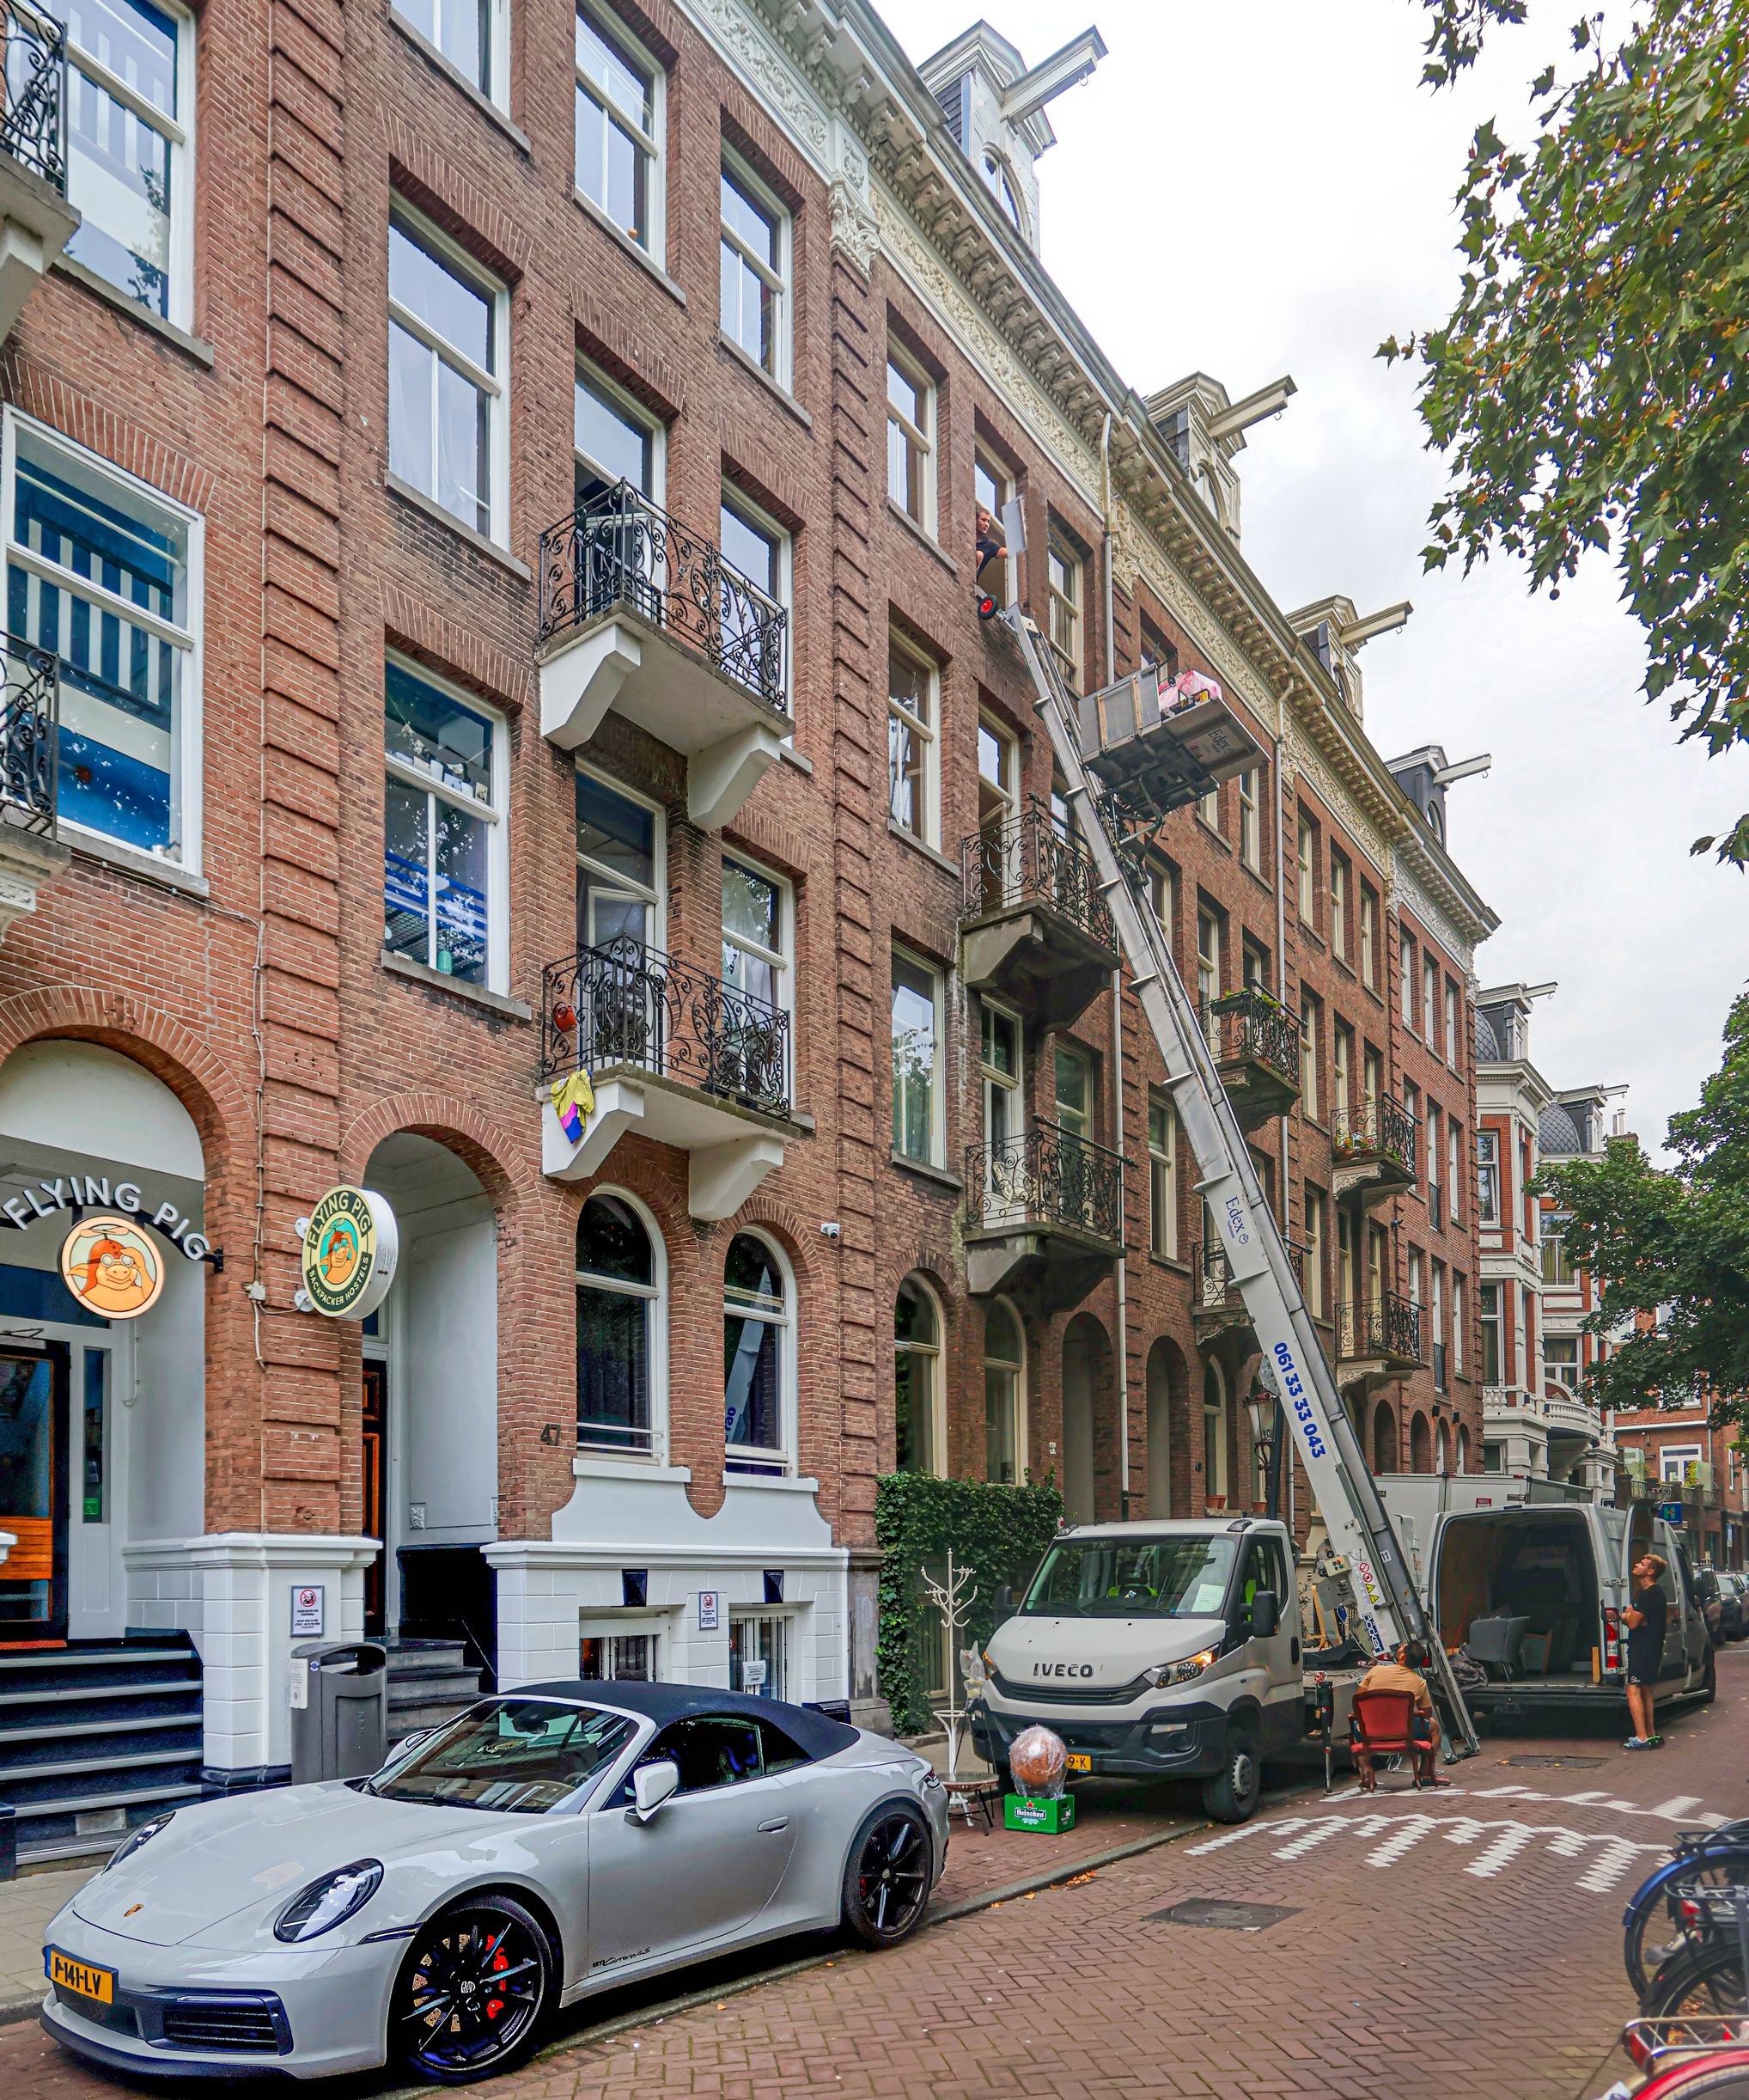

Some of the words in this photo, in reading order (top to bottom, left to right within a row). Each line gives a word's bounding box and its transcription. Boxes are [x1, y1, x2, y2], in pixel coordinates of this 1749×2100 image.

[2, 1175, 141, 1230] FLYING
[152, 1202, 210, 1261] PIG
[308, 1191, 350, 1246] FLYING
[351, 1198, 371, 1233] PIG
[1226, 1196, 1244, 1233] Edex
[308, 1269, 344, 1306] BACKPACKER
[345, 1256, 369, 1301] HOSTELS
[1274, 1342, 1295, 1373] 061
[1285, 1373, 1303, 1397] 33
[1295, 1398, 1313, 1421] 33
[540, 1423, 561, 1446] 47
[1303, 1423, 1326, 1458] 043
[1033, 1663, 1094, 1678] IVECO
[1068, 1756, 1087, 1768] 9-K
[1016, 1808, 1045, 1818] Heineken
